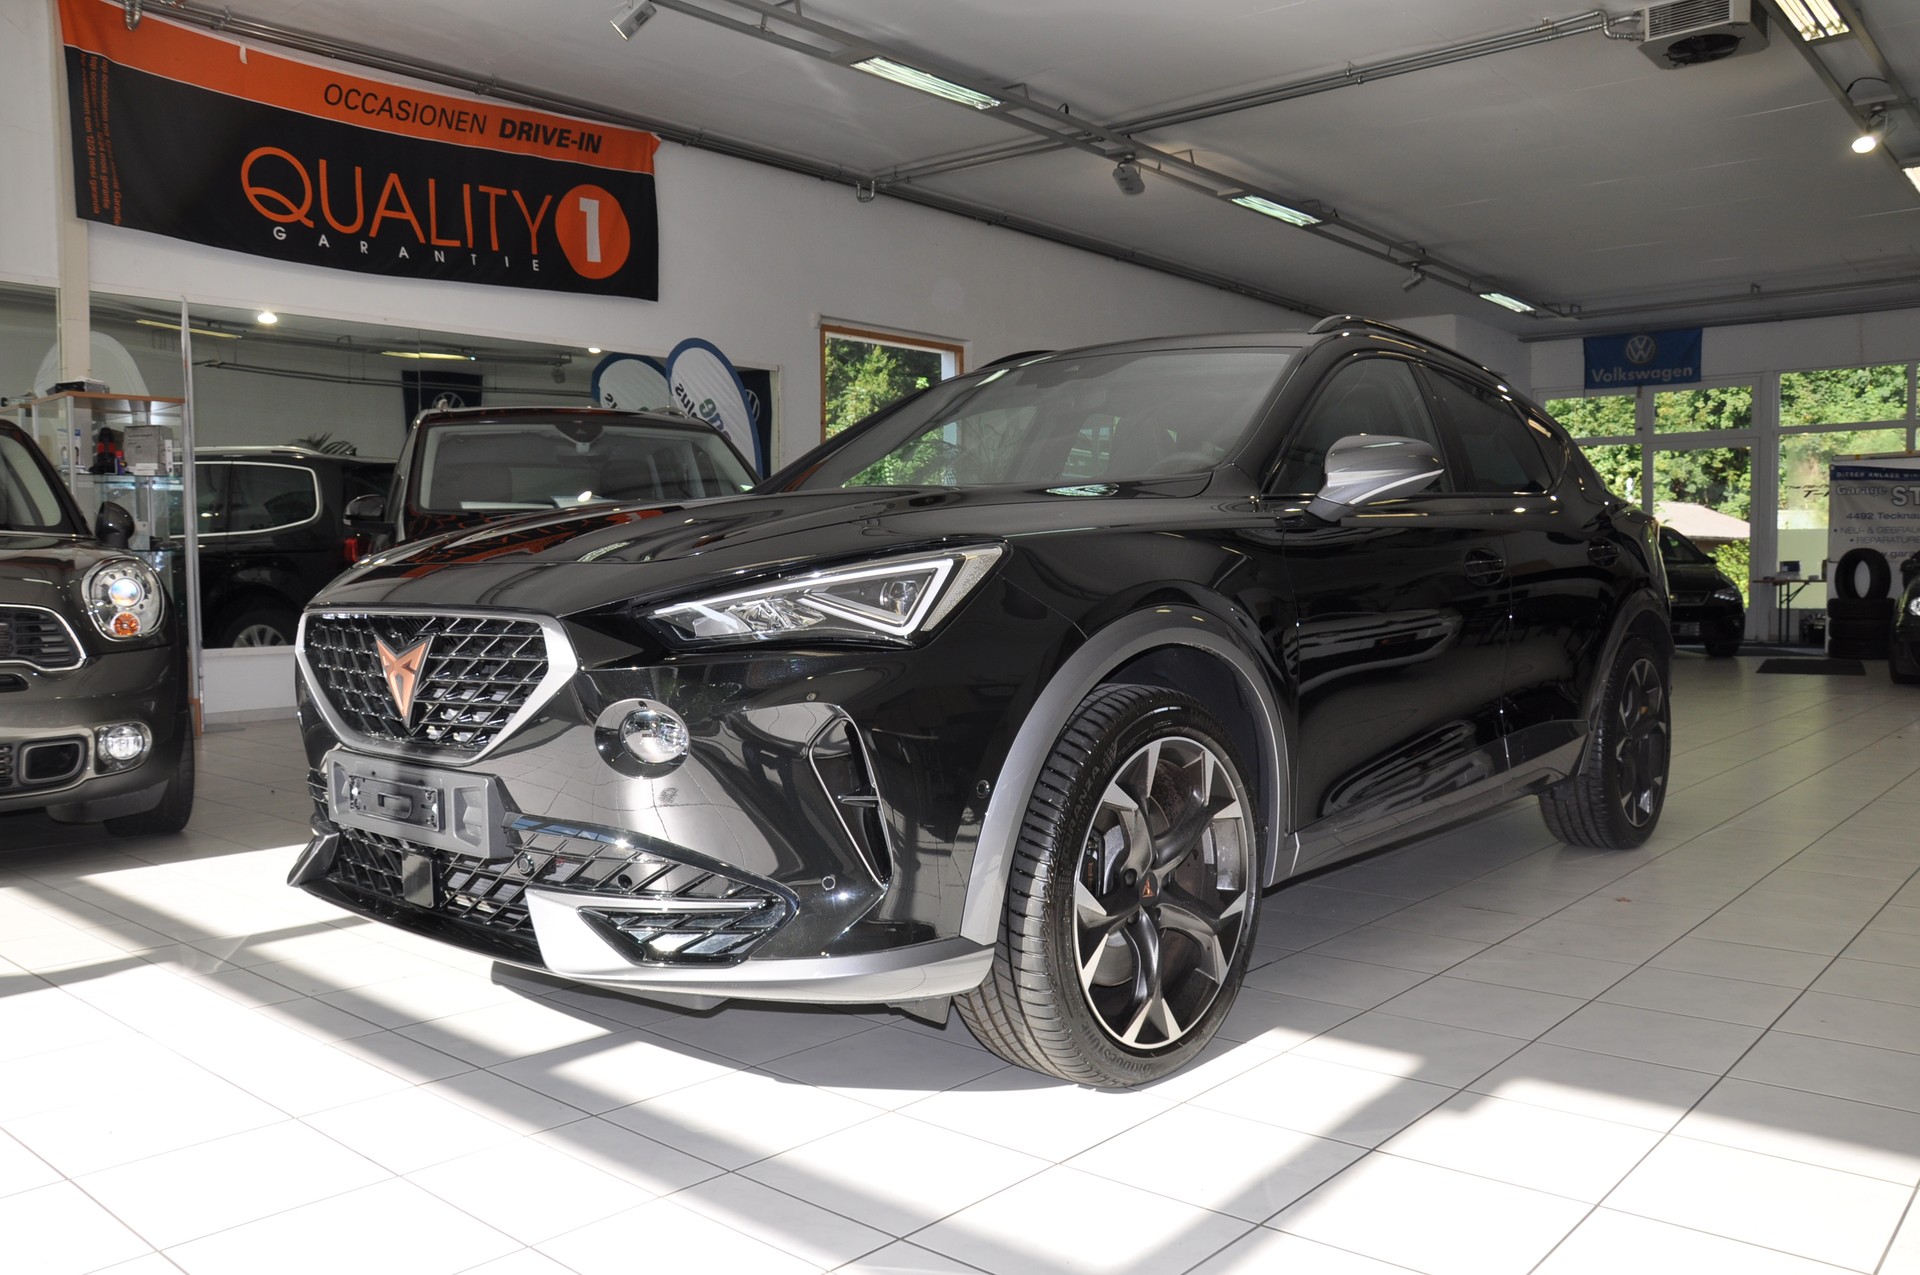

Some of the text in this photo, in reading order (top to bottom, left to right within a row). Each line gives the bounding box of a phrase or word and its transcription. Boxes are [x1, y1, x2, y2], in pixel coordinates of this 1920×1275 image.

[323, 83, 602, 154] OCCASIONEN DRIVE-IN
[101, 174, 110, 209] garantie
[114, 191, 122, 226] Garantie
[241, 146, 602, 263] QUALITY 1
[272, 226, 540, 272] GARANTIE
[1591, 366, 1693, 382] Volkswagen
[1836, 485, 1888, 497] Garage
[1846, 512, 1874, 520] 4492
